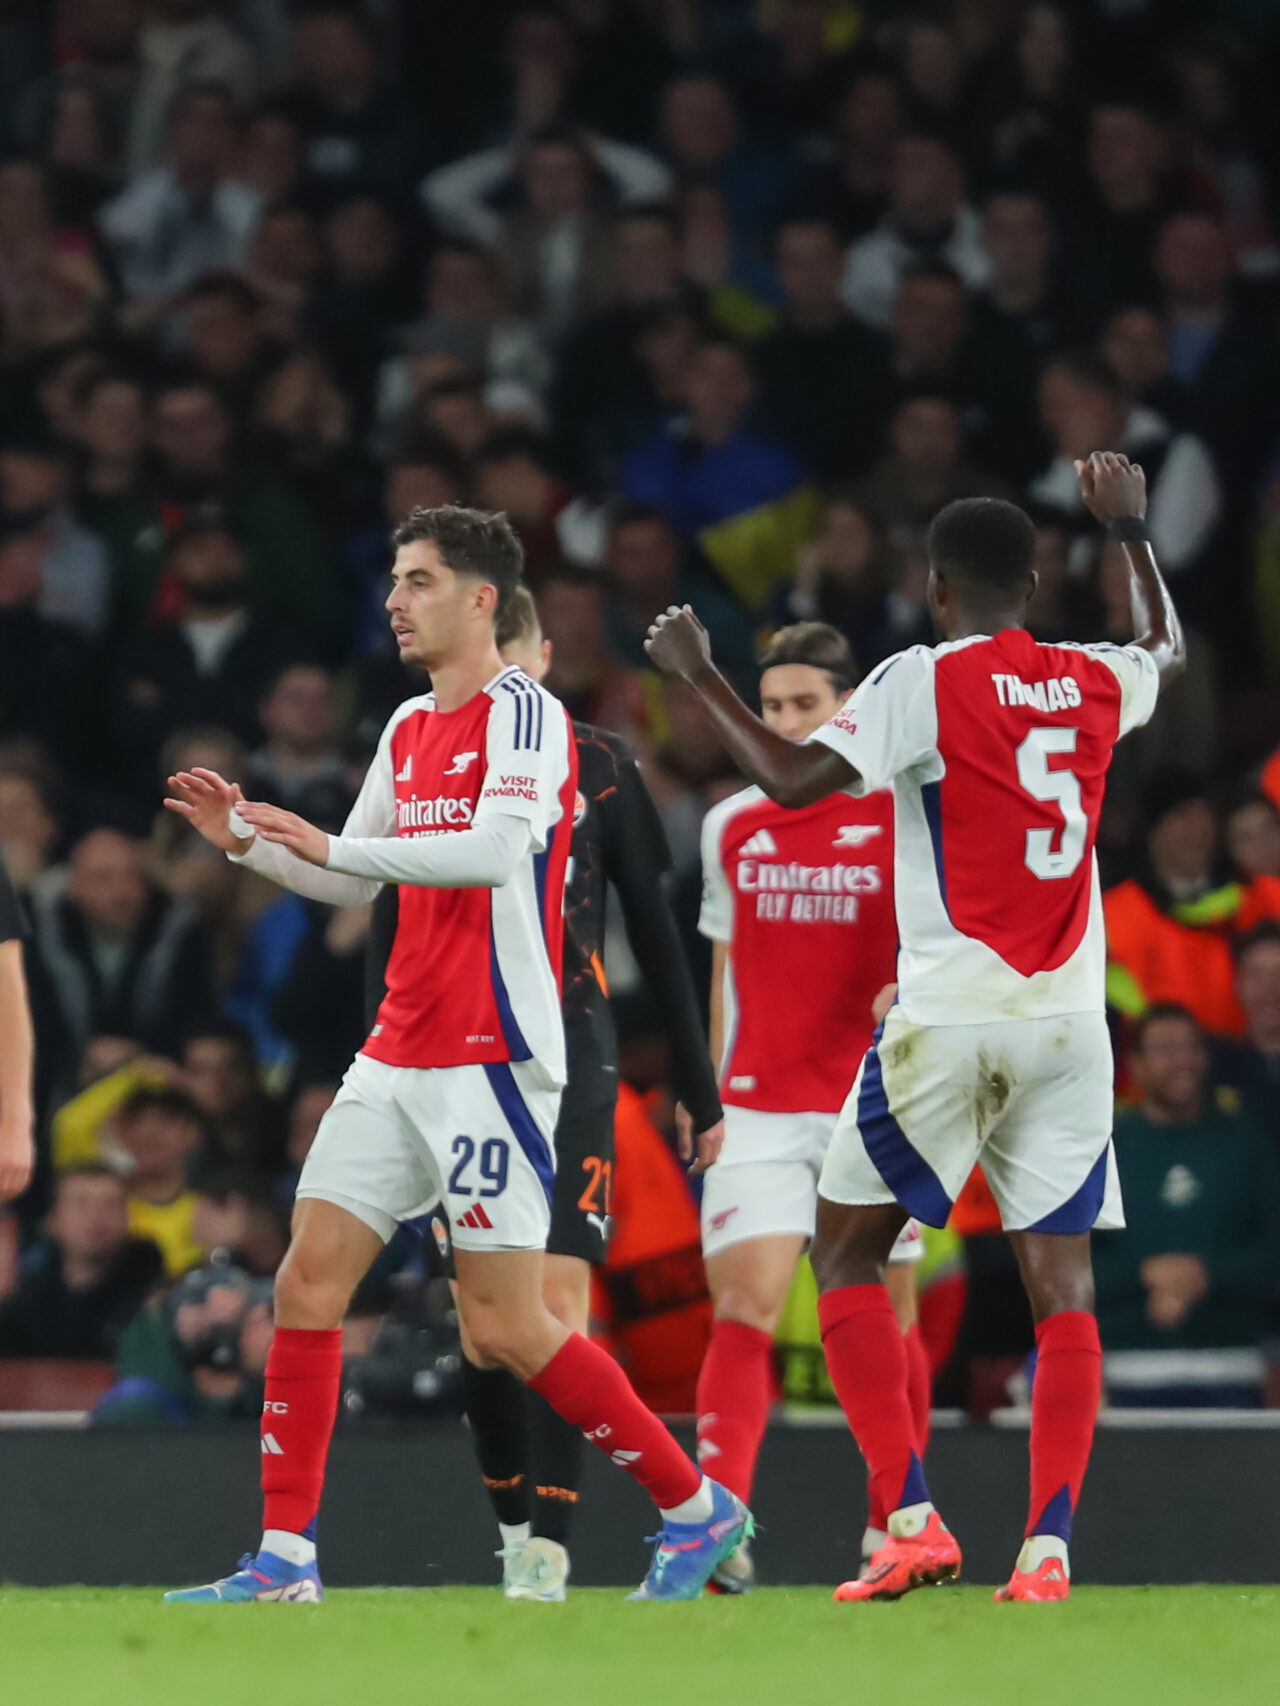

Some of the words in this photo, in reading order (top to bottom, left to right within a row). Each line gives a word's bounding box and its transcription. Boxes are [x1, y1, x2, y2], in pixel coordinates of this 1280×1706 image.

[484, 787, 538, 803] RWAND
[500, 775, 537, 788] VISIT
[1015, 726, 1089, 880] 5
[737, 859, 882, 893] Emirates
[756, 892, 787, 919] FLY
[790, 893, 860, 924] BETTER
[449, 1135, 509, 1197] 29
[577, 1155, 612, 1213] 21
[263, 1400, 289, 1414] FC
